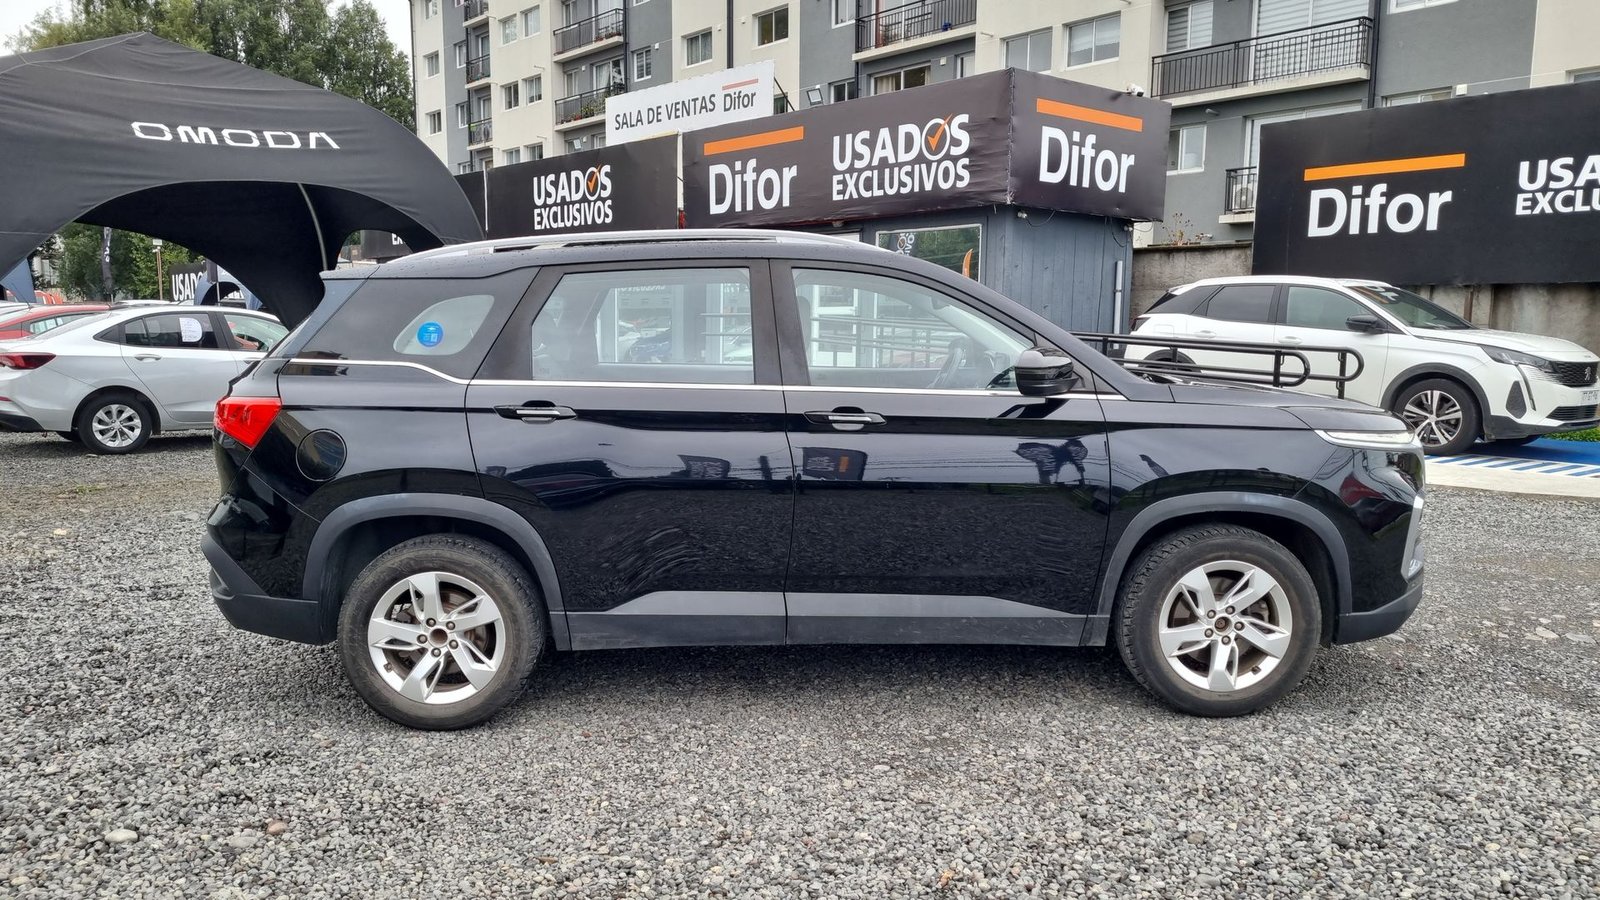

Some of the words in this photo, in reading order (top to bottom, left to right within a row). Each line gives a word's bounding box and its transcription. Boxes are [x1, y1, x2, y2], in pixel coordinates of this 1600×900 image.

[614, 109, 643, 131] SALA
[646, 105, 663, 124] DE
[665, 94, 717, 121] VENTAS
[722, 90, 757, 112] Difor
[131, 121, 340, 149] OMODA
[832, 113, 970, 171] USADOS
[832, 157, 970, 201] EXCLUSIVOS
[1039, 125, 1135, 194] Difor
[533, 164, 612, 206] USADOS
[708, 158, 798, 215] Difor
[533, 199, 613, 230] EXCLUSIVOS
[1307, 183, 1453, 238] Difor
